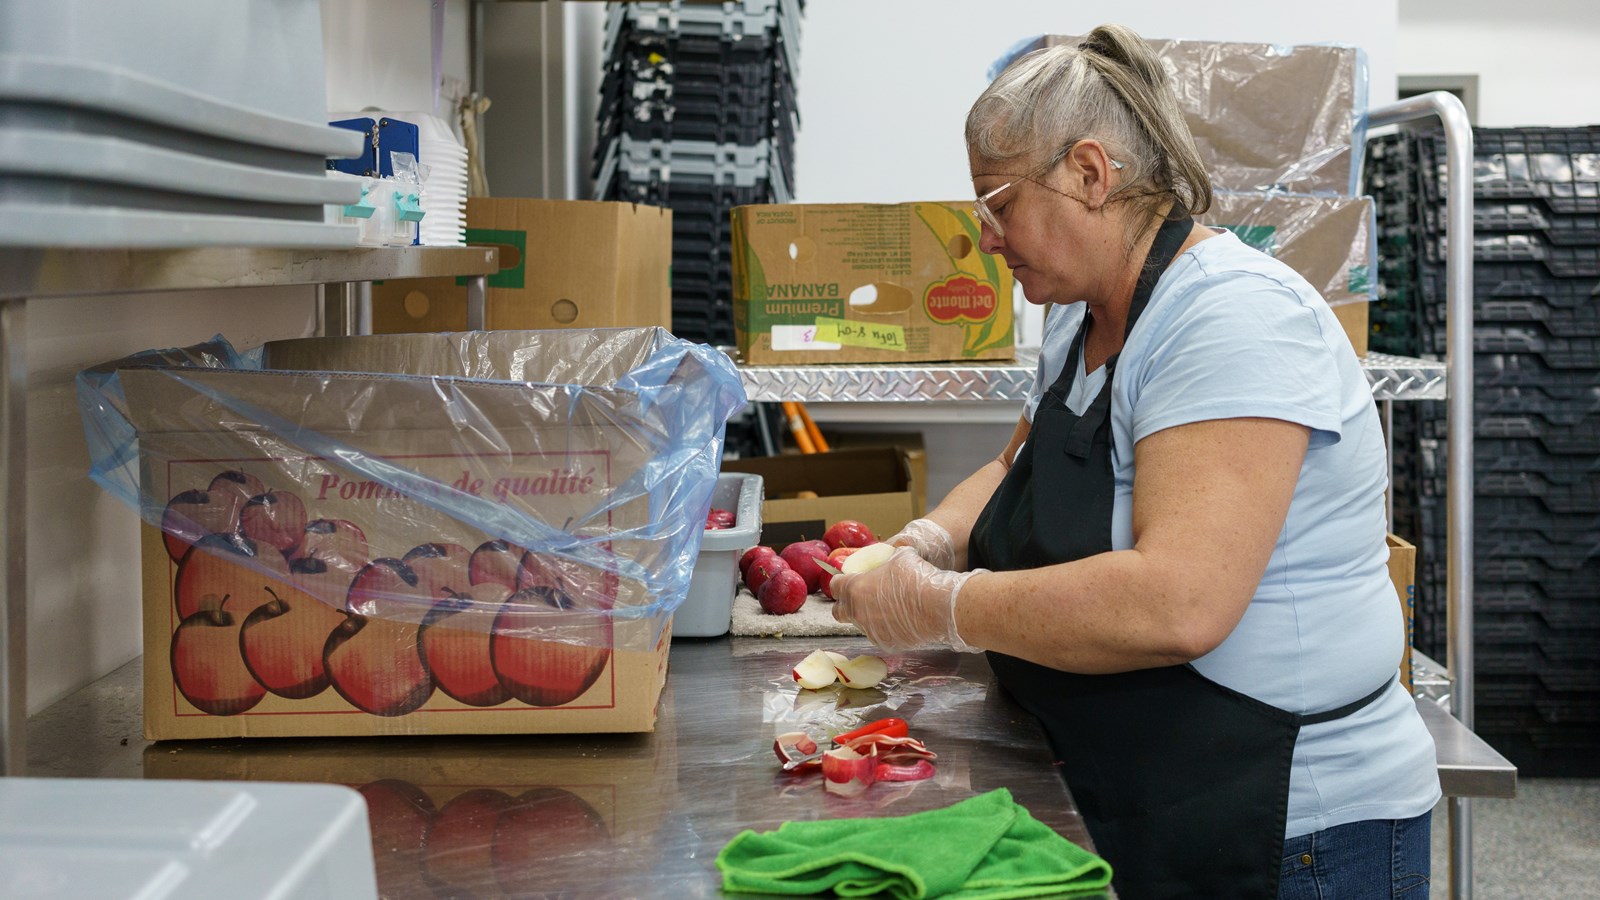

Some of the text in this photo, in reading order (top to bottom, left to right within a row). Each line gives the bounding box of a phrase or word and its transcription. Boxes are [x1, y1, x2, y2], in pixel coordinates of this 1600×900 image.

[765, 302, 839, 317] Premium
[929, 295, 993, 309] Del Monte
[451, 469, 485, 497] de
[493, 466, 596, 504] qualité
